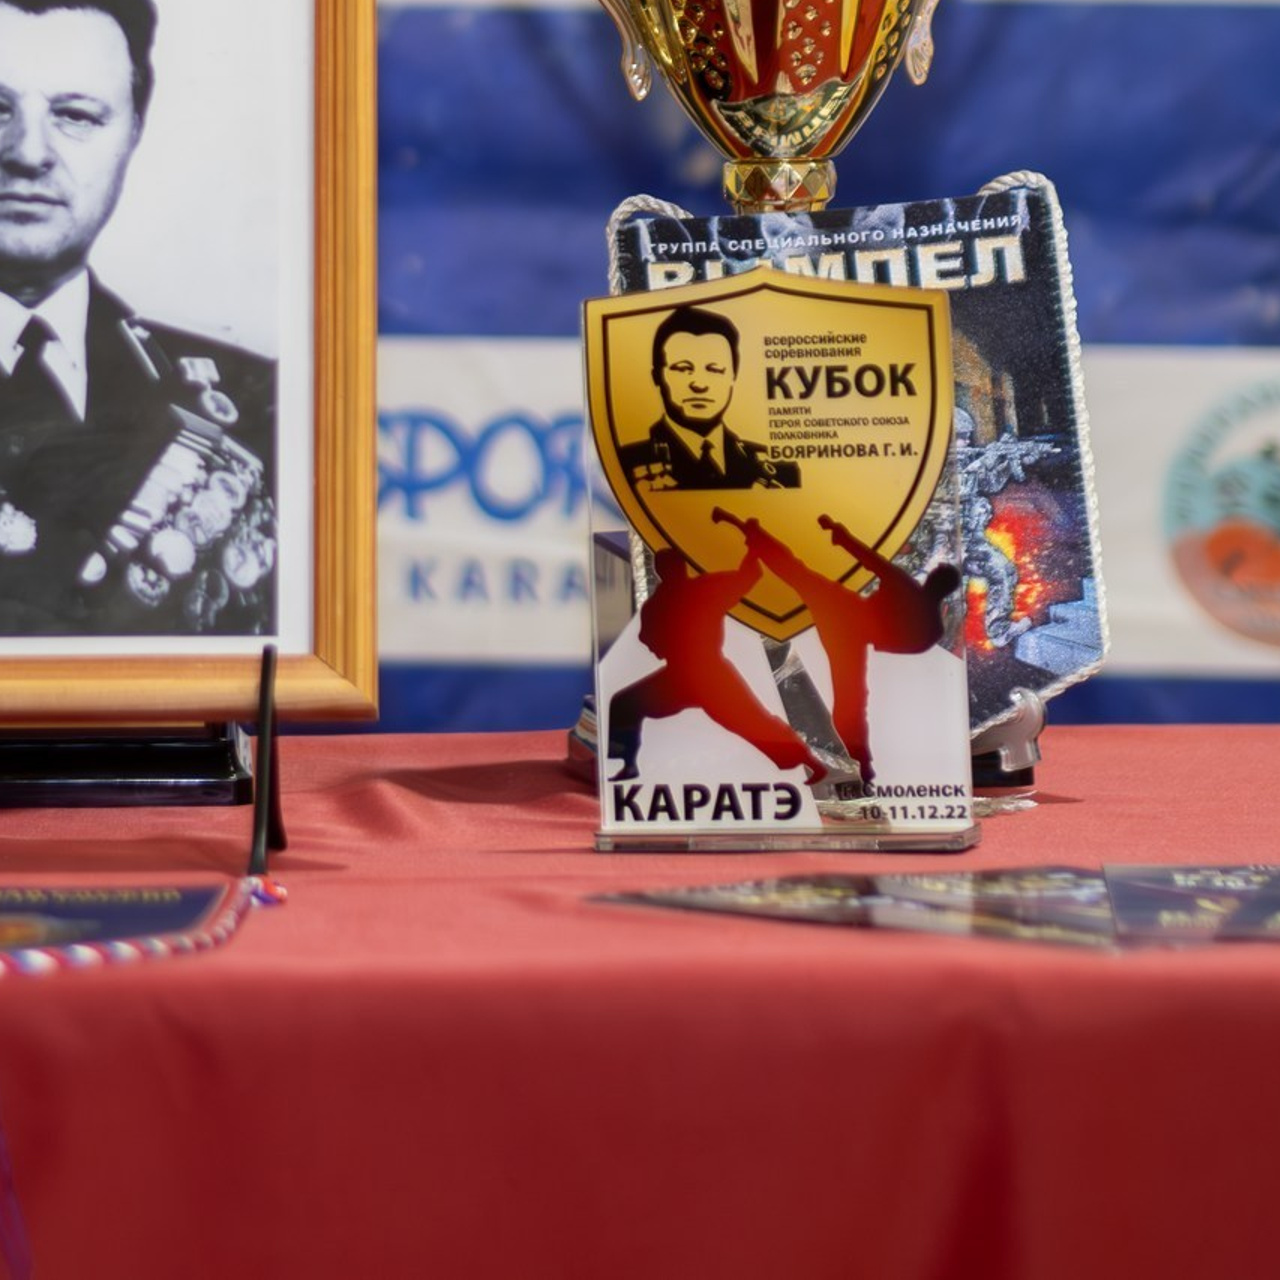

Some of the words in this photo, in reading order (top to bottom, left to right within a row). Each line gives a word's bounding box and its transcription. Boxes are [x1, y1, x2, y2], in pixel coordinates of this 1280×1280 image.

[648, 241, 720, 255] ГРУППА
[728, 229, 884, 252] СПЕЦИАЛЬНОГО
[892, 215, 1023, 238] НАЗНАЧЕНИЯ
[764, 331, 867, 347] всероссийские
[764, 347, 862, 361] соревнования
[765, 362, 918, 400] КУБОК
[768, 406, 812, 417] ПАМЯТИ
[769, 419, 801, 428] ГЕРОЯ
[803, 417, 869, 427] СОВЕТСКОГО
[872, 416, 910, 426] СОЮЗА
[769, 430, 839, 441] ПОЛКОВНИКА
[770, 443, 879, 460] БОЯРИНОВА
[883, 443, 896, 457] Г.
[900, 443, 918, 457] И.
[407, 558, 589, 602] KARA
[863, 782, 966, 799] Смоленск
[613, 782, 802, 821] КАРАТЭ
[861, 804, 968, 820] 10-11.12.22
